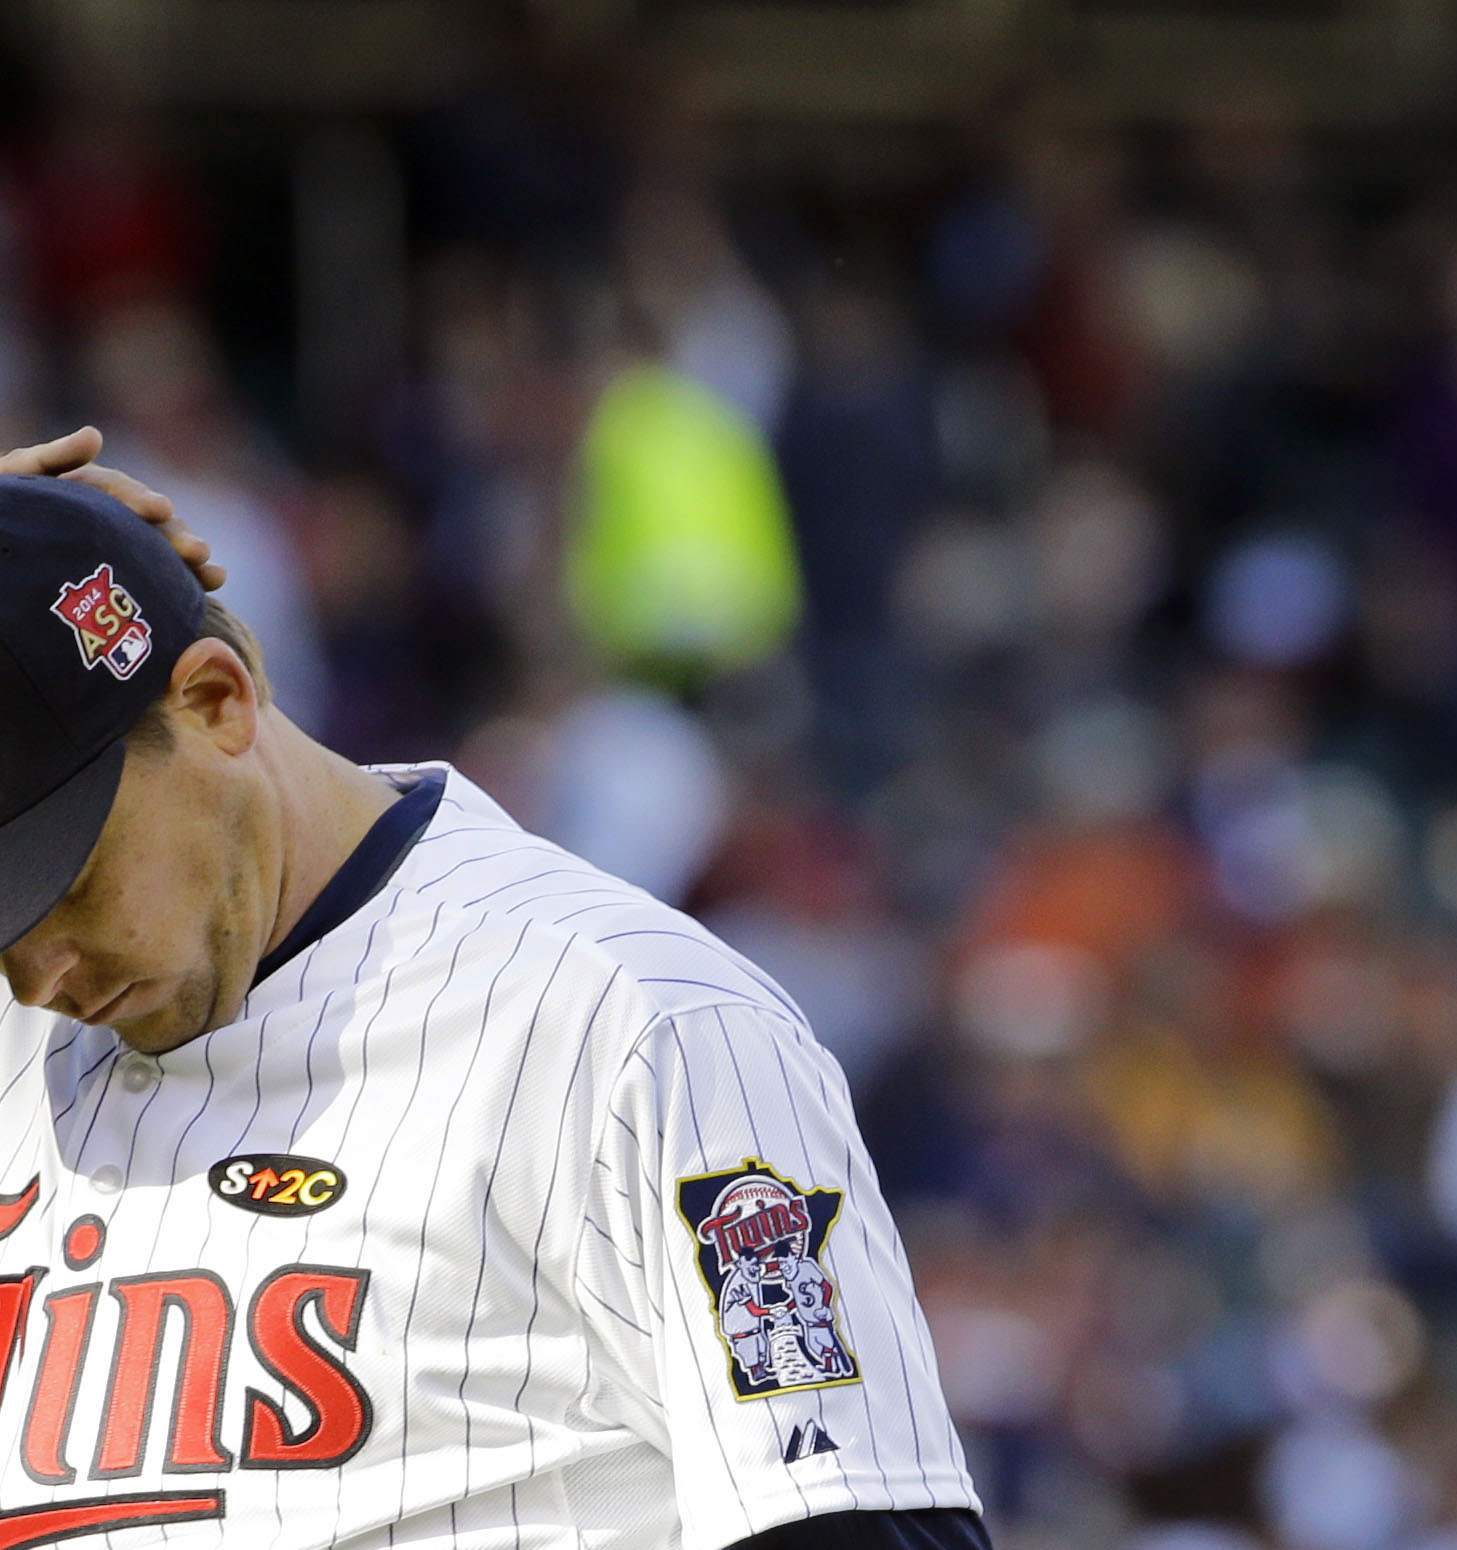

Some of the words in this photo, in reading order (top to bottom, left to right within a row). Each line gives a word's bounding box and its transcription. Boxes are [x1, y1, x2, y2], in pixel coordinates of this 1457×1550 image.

[72, 588, 102, 621] 2014
[80, 588, 134, 661] ASG
[700, 1199, 809, 1264] Twins
